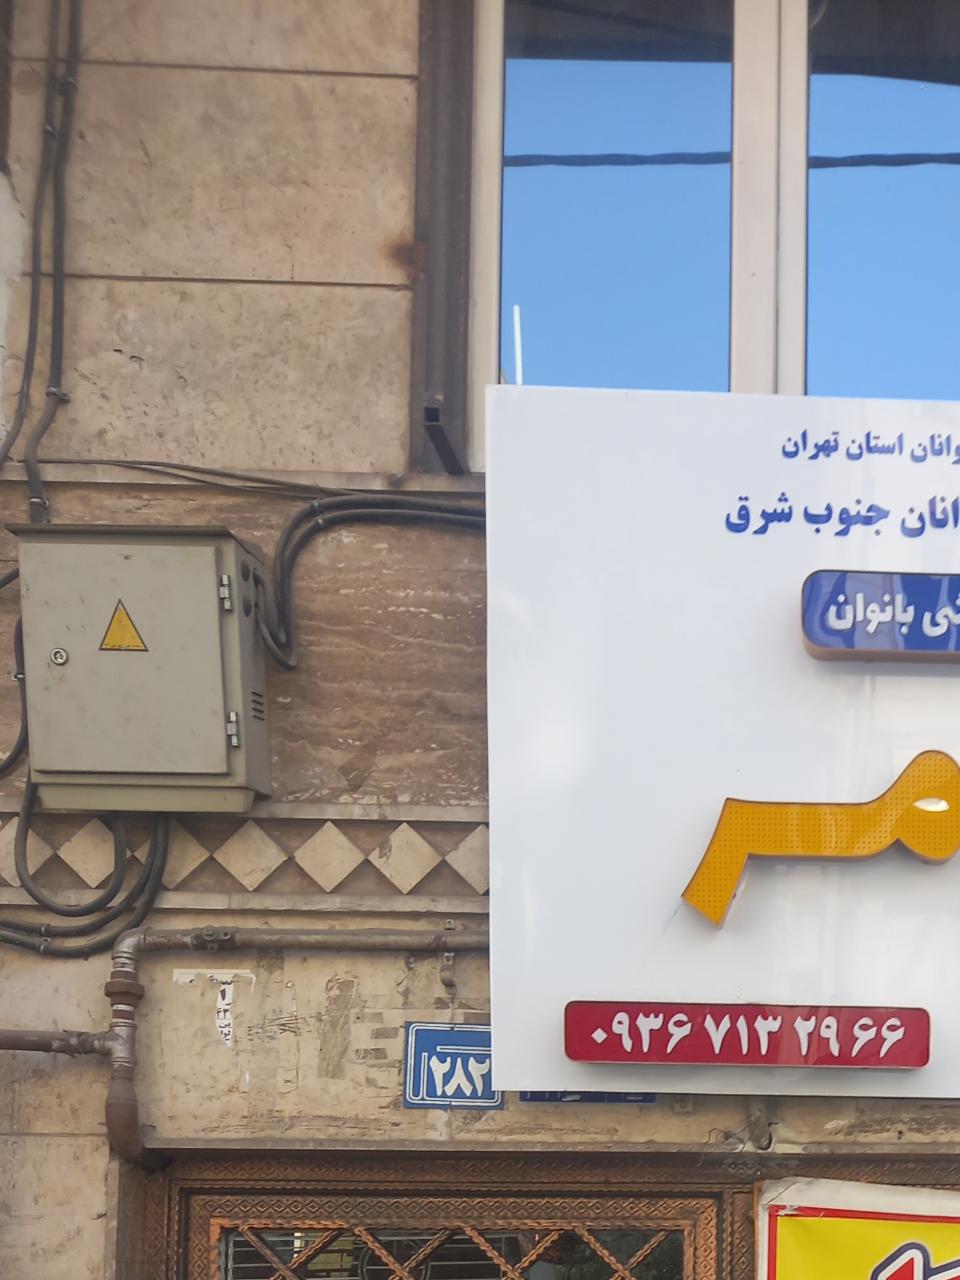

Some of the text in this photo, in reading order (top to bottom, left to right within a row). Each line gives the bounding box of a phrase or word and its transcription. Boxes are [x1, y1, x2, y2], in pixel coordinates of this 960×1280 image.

[781, 429, 839, 460] تهران
[845, 431, 904, 461] استان
[725, 491, 793, 535] شرق
[802, 497, 890, 536] جنوب
[826, 592, 915, 635] بانوان
[591, 1011, 905, 1058] ۰۹۳۶ ۷۱۳ ۲۹ ۶۶
[429, 1055, 491, 1097] ۲۸۲
